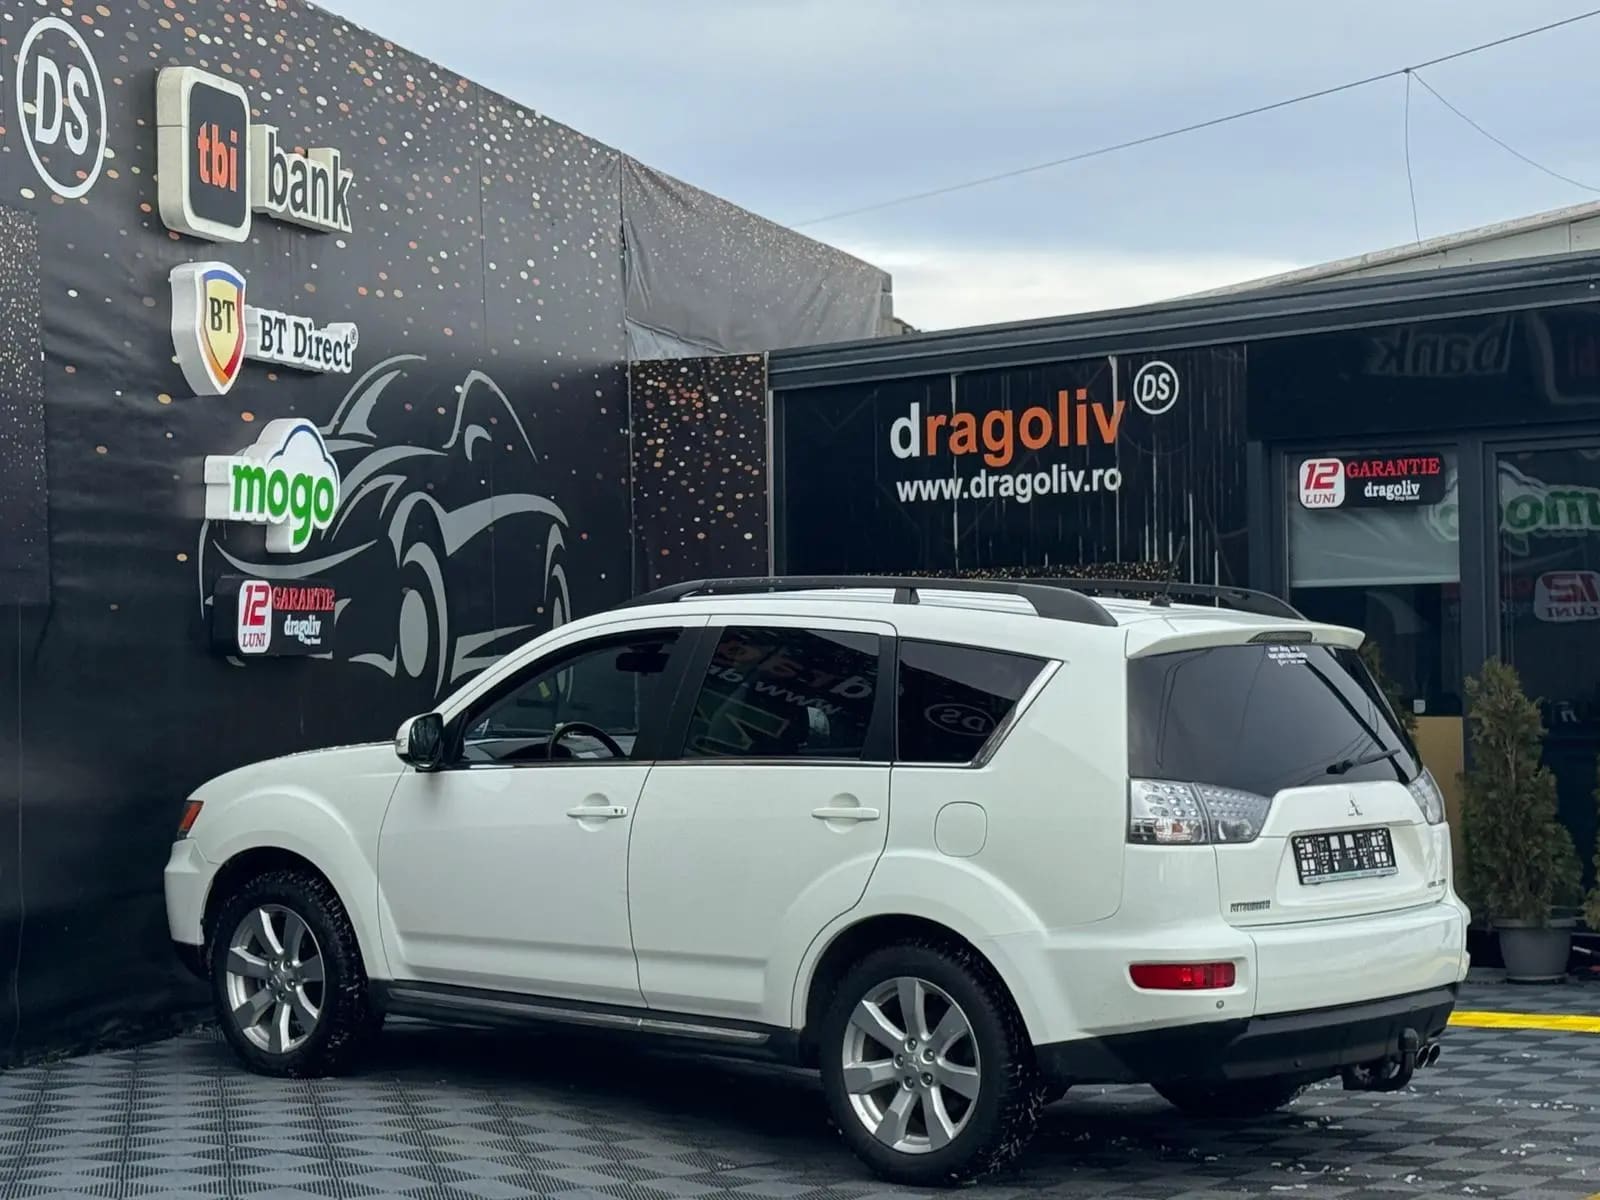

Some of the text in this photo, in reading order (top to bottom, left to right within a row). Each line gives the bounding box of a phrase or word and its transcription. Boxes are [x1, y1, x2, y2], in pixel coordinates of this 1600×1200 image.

[35, 55, 90, 155] DS
[197, 121, 351, 228] tbi bank
[209, 297, 236, 333] BT
[260, 314, 287, 355] BT
[1141, 372, 1170, 401] DS
[890, 387, 1125, 467] dragoliv
[896, 464, 1122, 503] www.dragoliv.ro
[1304, 462, 1339, 490] 12
[1346, 458, 1440, 478] GARANTIE
[232, 463, 334, 545] mogo
[1305, 494, 1336, 504] LUNI
[1364, 480, 1420, 500] dragoliv
[242, 585, 270, 626] 12
[272, 586, 335, 611] GARANTIE
[242, 633, 266, 647] LUNI
[284, 614, 321, 641] dragoliv
